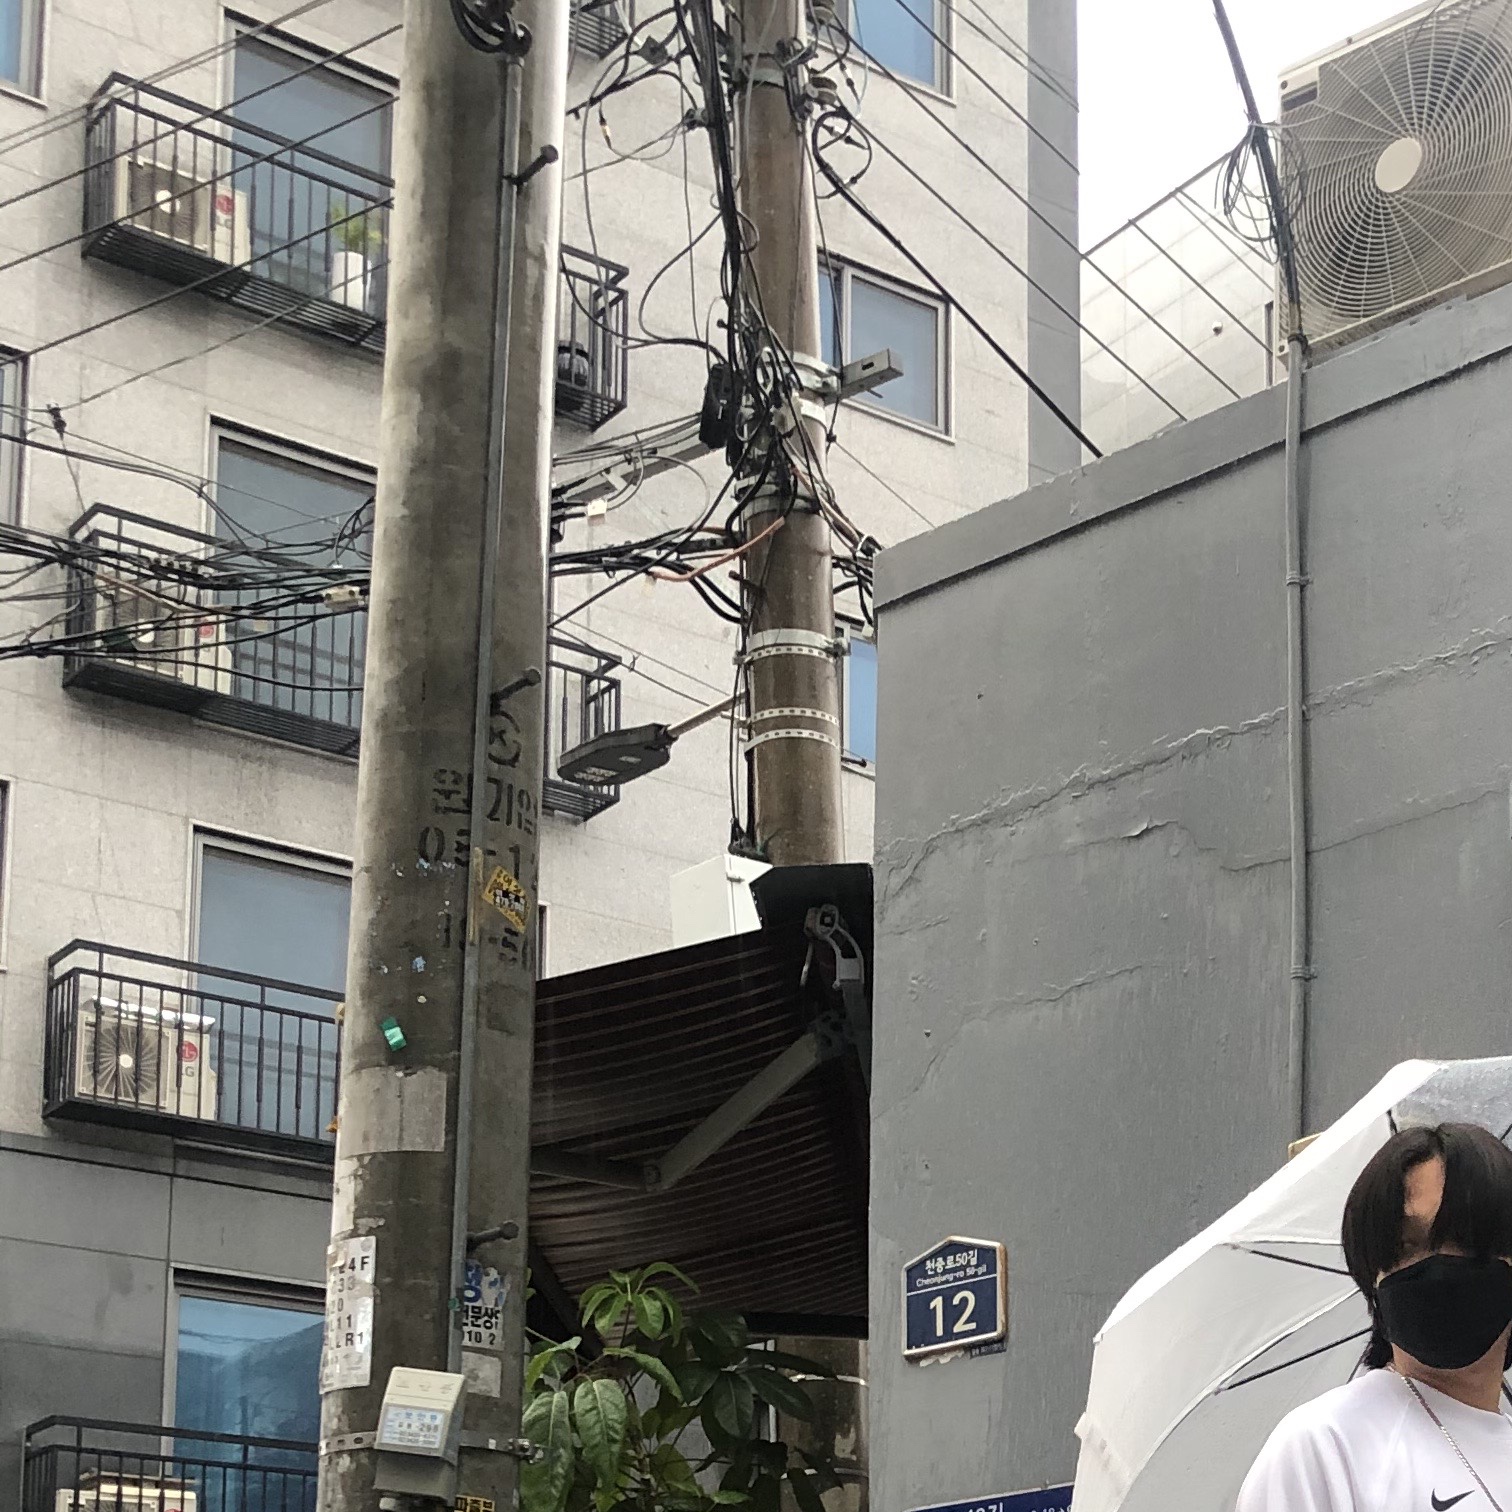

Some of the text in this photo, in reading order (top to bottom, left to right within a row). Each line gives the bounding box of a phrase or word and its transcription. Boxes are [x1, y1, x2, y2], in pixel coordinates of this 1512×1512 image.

[925, 1249, 977, 1275] 천중로50길
[916, 1270, 965, 1287] Cheonjung-ro
[930, 1290, 977, 1337] 12
